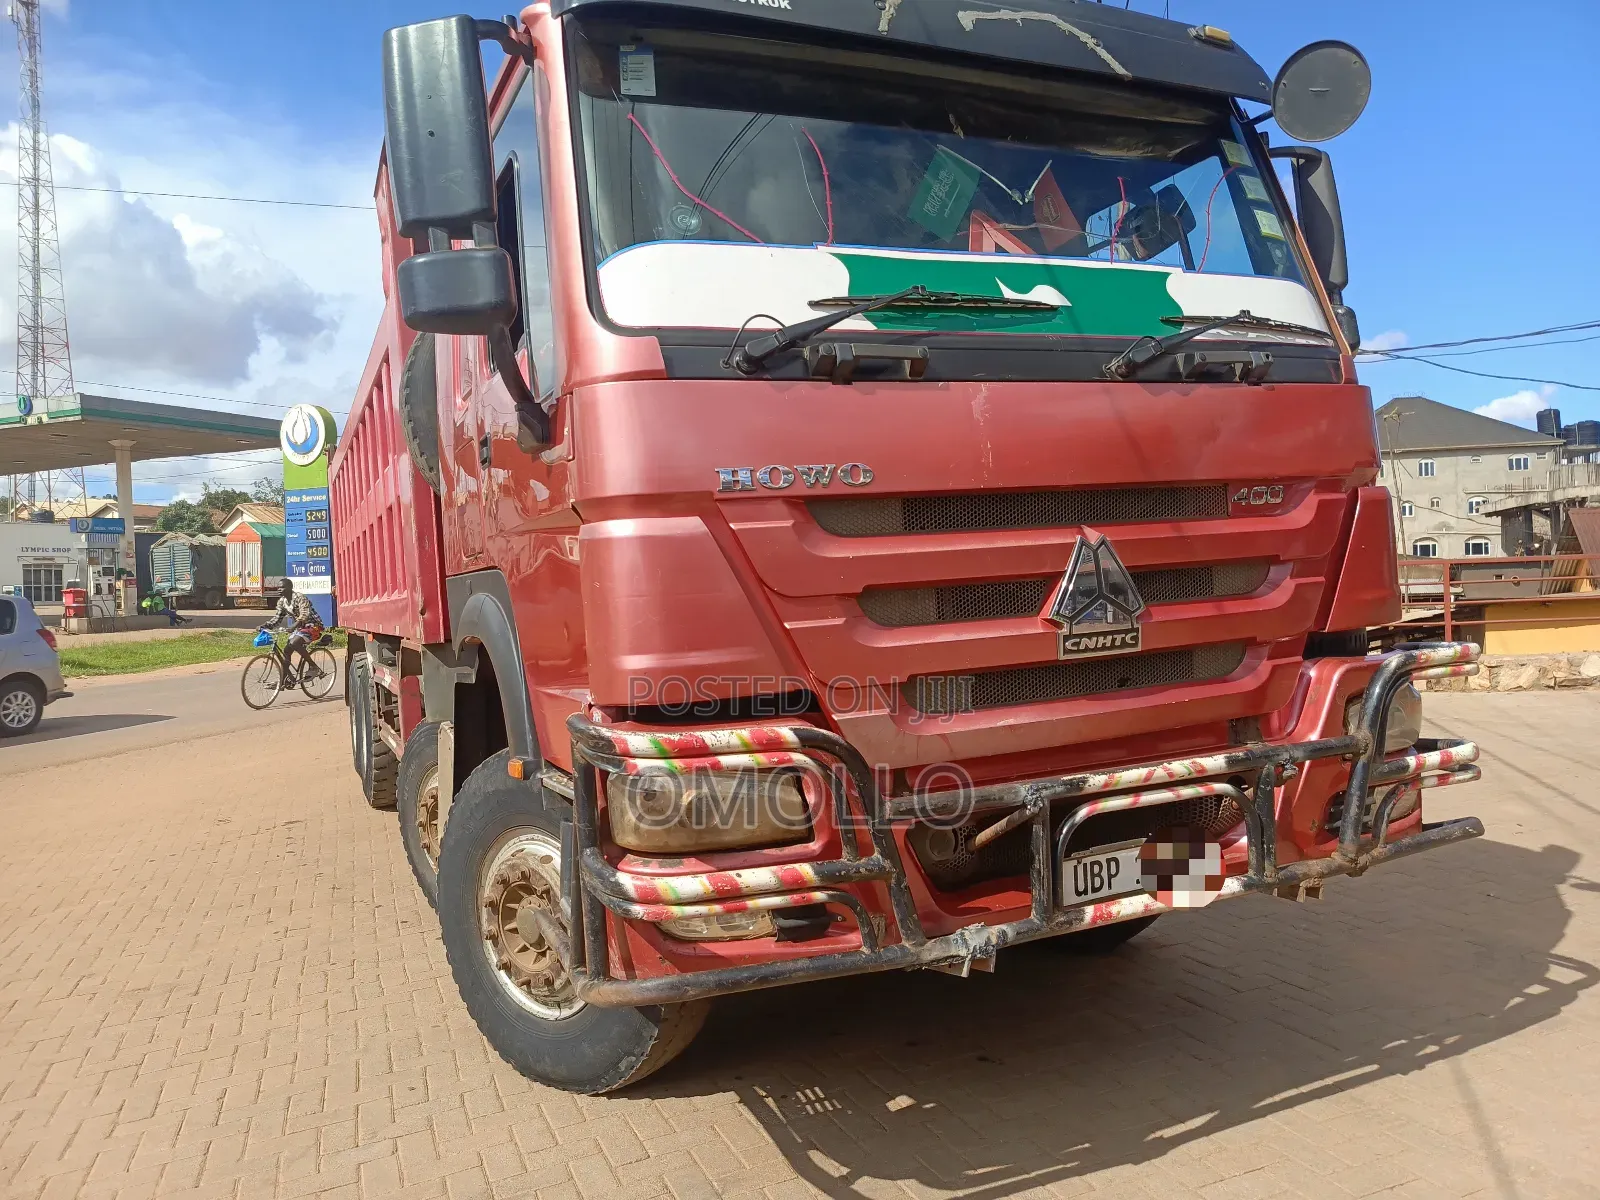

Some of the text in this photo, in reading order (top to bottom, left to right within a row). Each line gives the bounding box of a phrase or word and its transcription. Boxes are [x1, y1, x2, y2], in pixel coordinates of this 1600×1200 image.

[714, 462, 875, 492] HOWO
[1231, 485, 1284, 505] 400
[307, 529, 326, 539] 5000
[307, 546, 328, 557] 4500
[292, 561, 326, 576] Tyre Centre
[293, 580, 330, 590] PERMARKET
[1065, 632, 1138, 651] CNHTC
[1073, 857, 1121, 898] UBP
